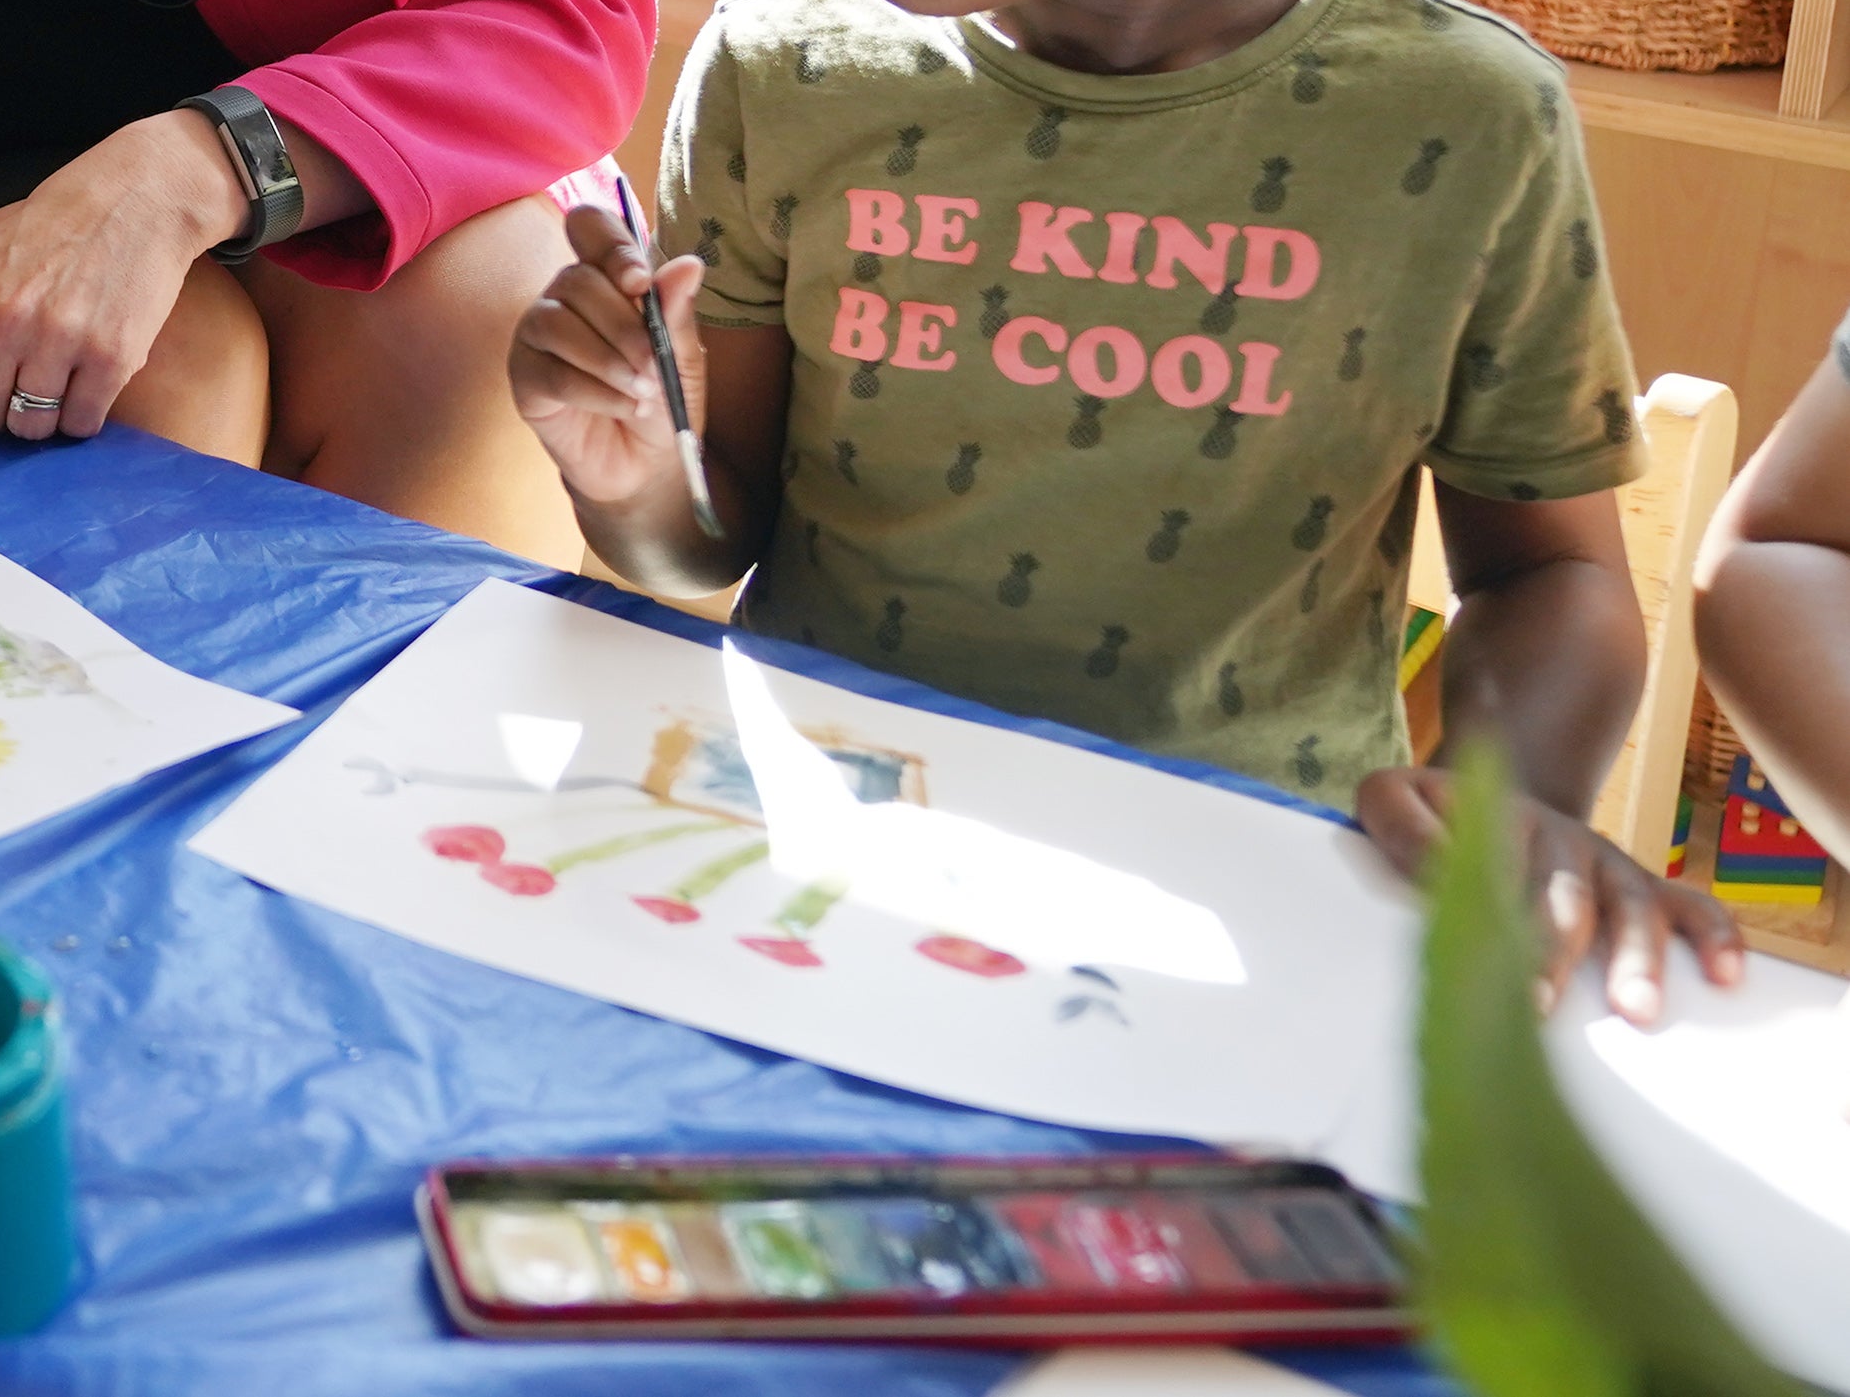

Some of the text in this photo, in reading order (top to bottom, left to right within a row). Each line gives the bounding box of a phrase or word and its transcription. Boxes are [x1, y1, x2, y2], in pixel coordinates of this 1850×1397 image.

[845, 188, 1321, 301] BE KIND
[829, 286, 1292, 416] BE COOL
